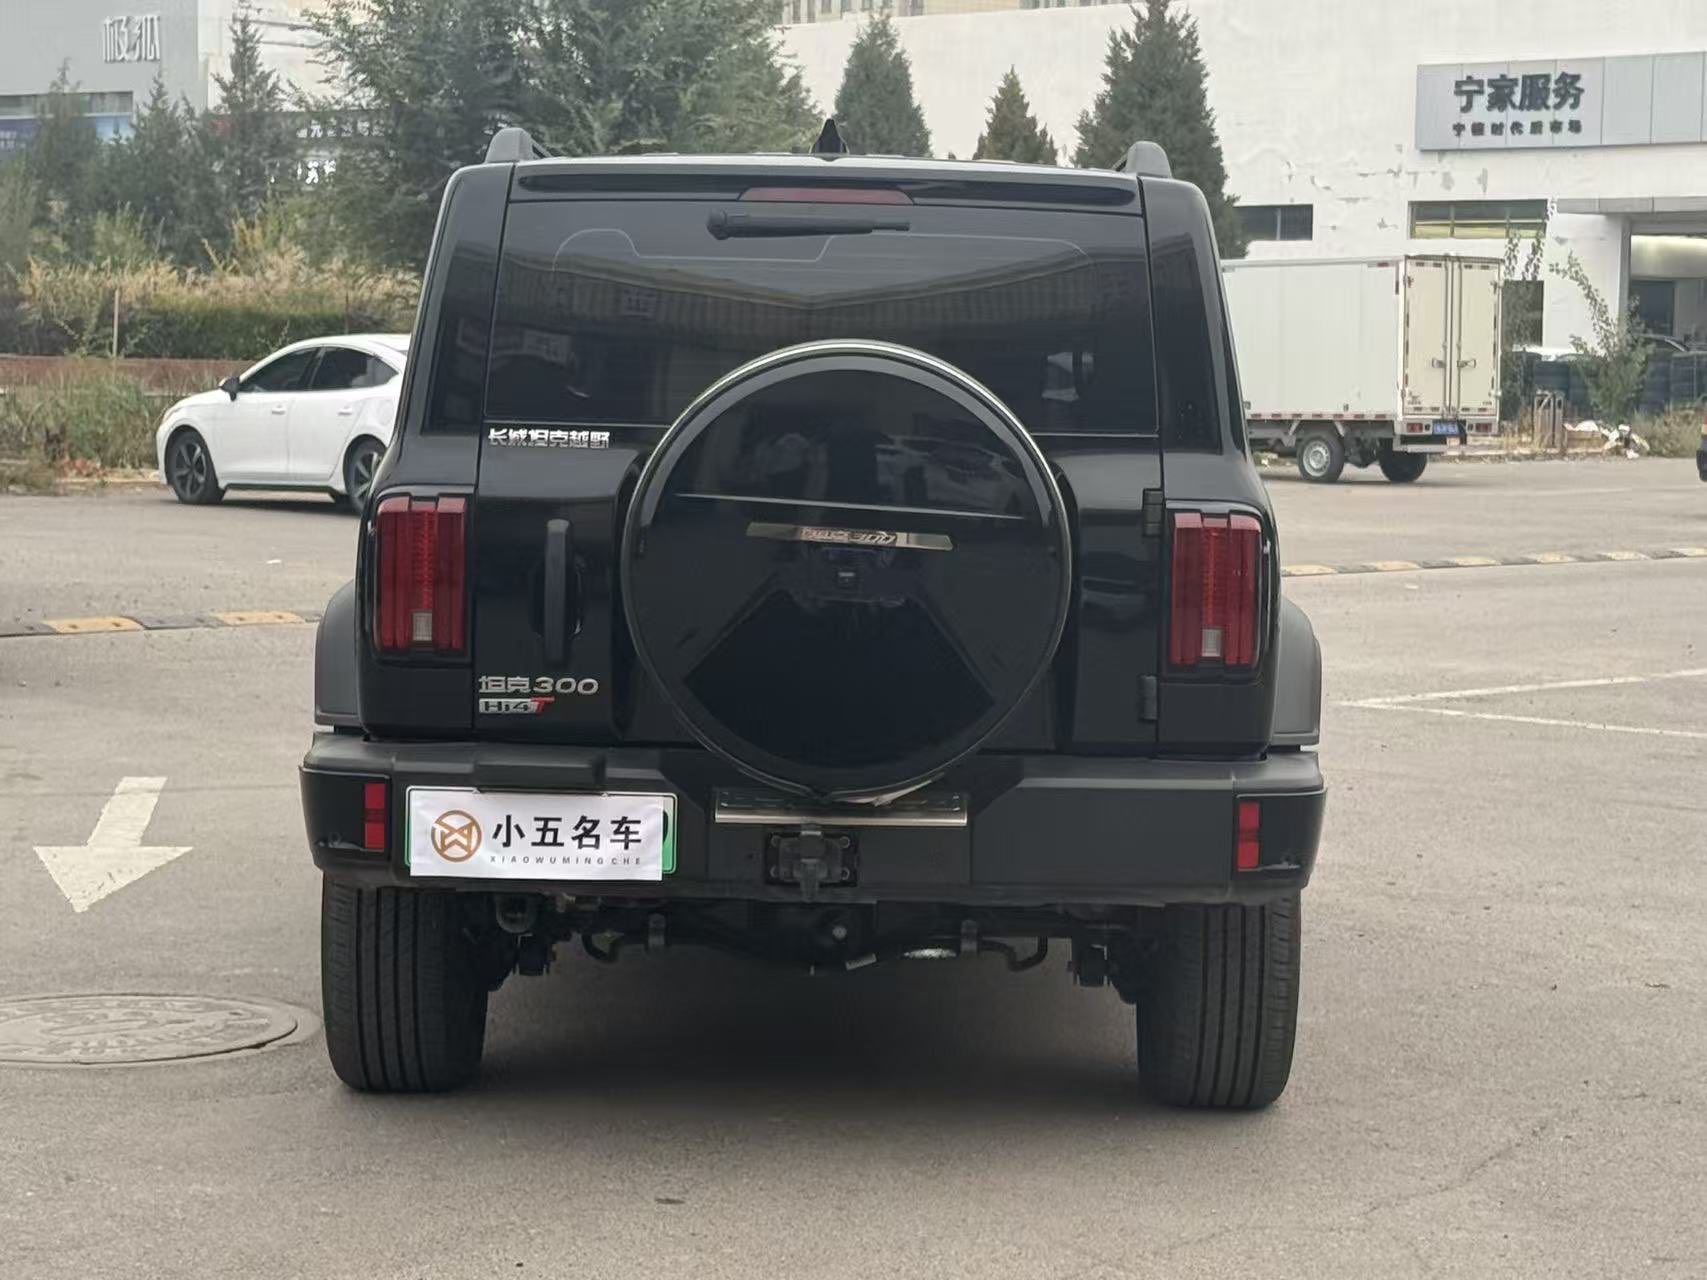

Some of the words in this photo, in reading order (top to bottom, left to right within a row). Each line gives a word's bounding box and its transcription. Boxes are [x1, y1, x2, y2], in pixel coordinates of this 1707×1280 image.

[1454, 71, 1585, 113] 宁家服务
[488, 428, 610, 448] 长城坦克越野
[479, 675, 599, 694] 坦克300
[492, 814, 642, 850] 小五名车
[490, 855, 642, 866] XIAOWUMINGCHE
